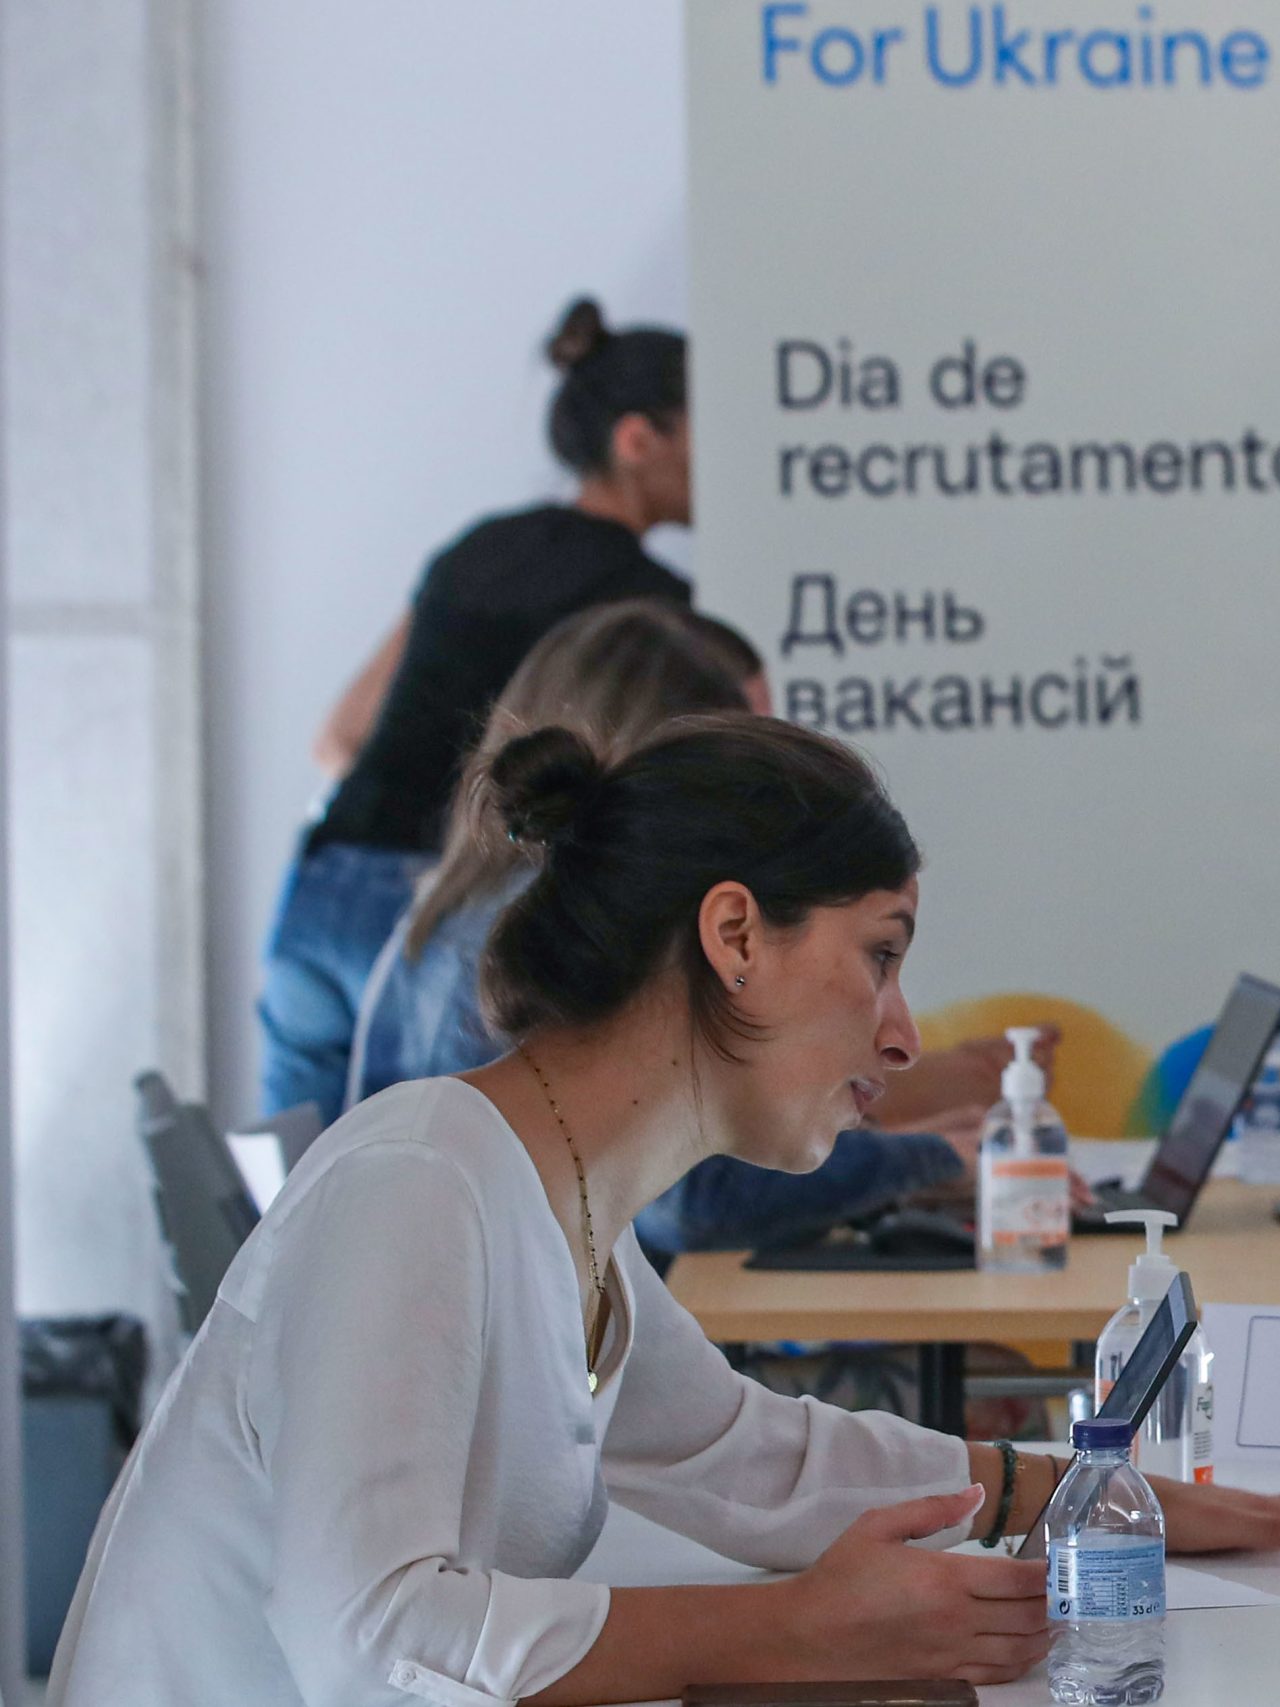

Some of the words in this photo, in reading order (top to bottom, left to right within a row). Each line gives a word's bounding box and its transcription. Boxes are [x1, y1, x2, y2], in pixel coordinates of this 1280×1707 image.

[761, 2, 902, 87] For
[924, 4, 1270, 89] Ukraine
[775, 338, 901, 411] Dia
[928, 338, 1027, 411] de
[779, 572, 985, 658] День
[783, 654, 1142, 734] вакансій
